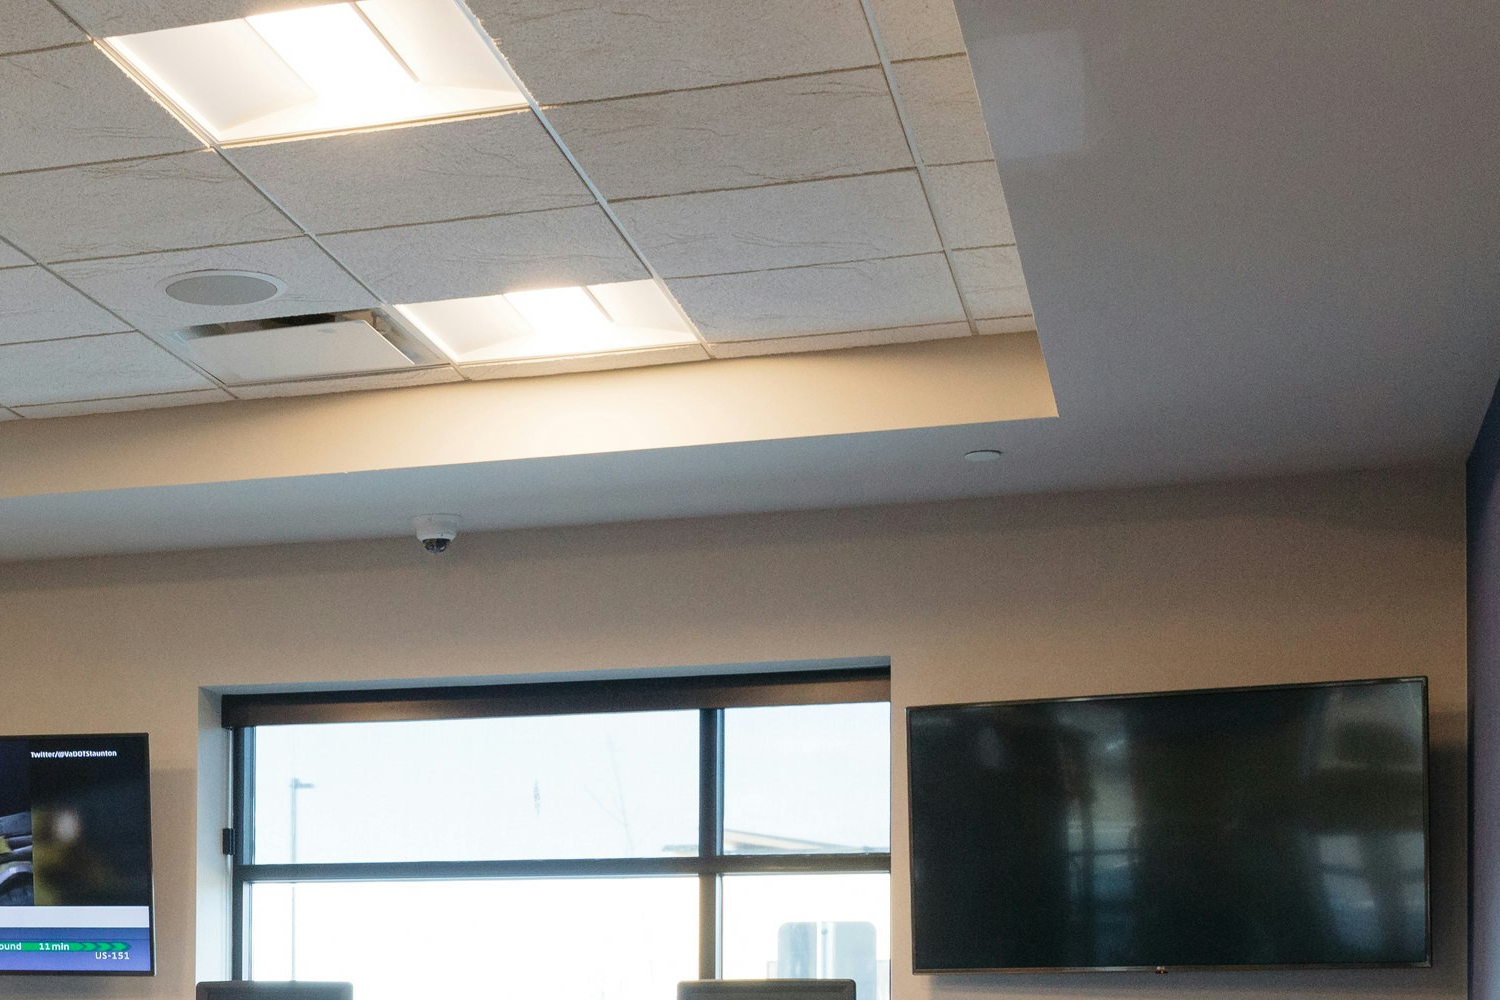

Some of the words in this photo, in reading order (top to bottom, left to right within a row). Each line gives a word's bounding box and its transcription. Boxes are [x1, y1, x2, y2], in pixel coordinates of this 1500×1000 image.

[30, 750, 118, 759] Twitter/@VaDOTStaunton
[39, 942, 50, 951] 11
[51, 942, 70, 951] min
[94, 951, 130, 960] US-151
